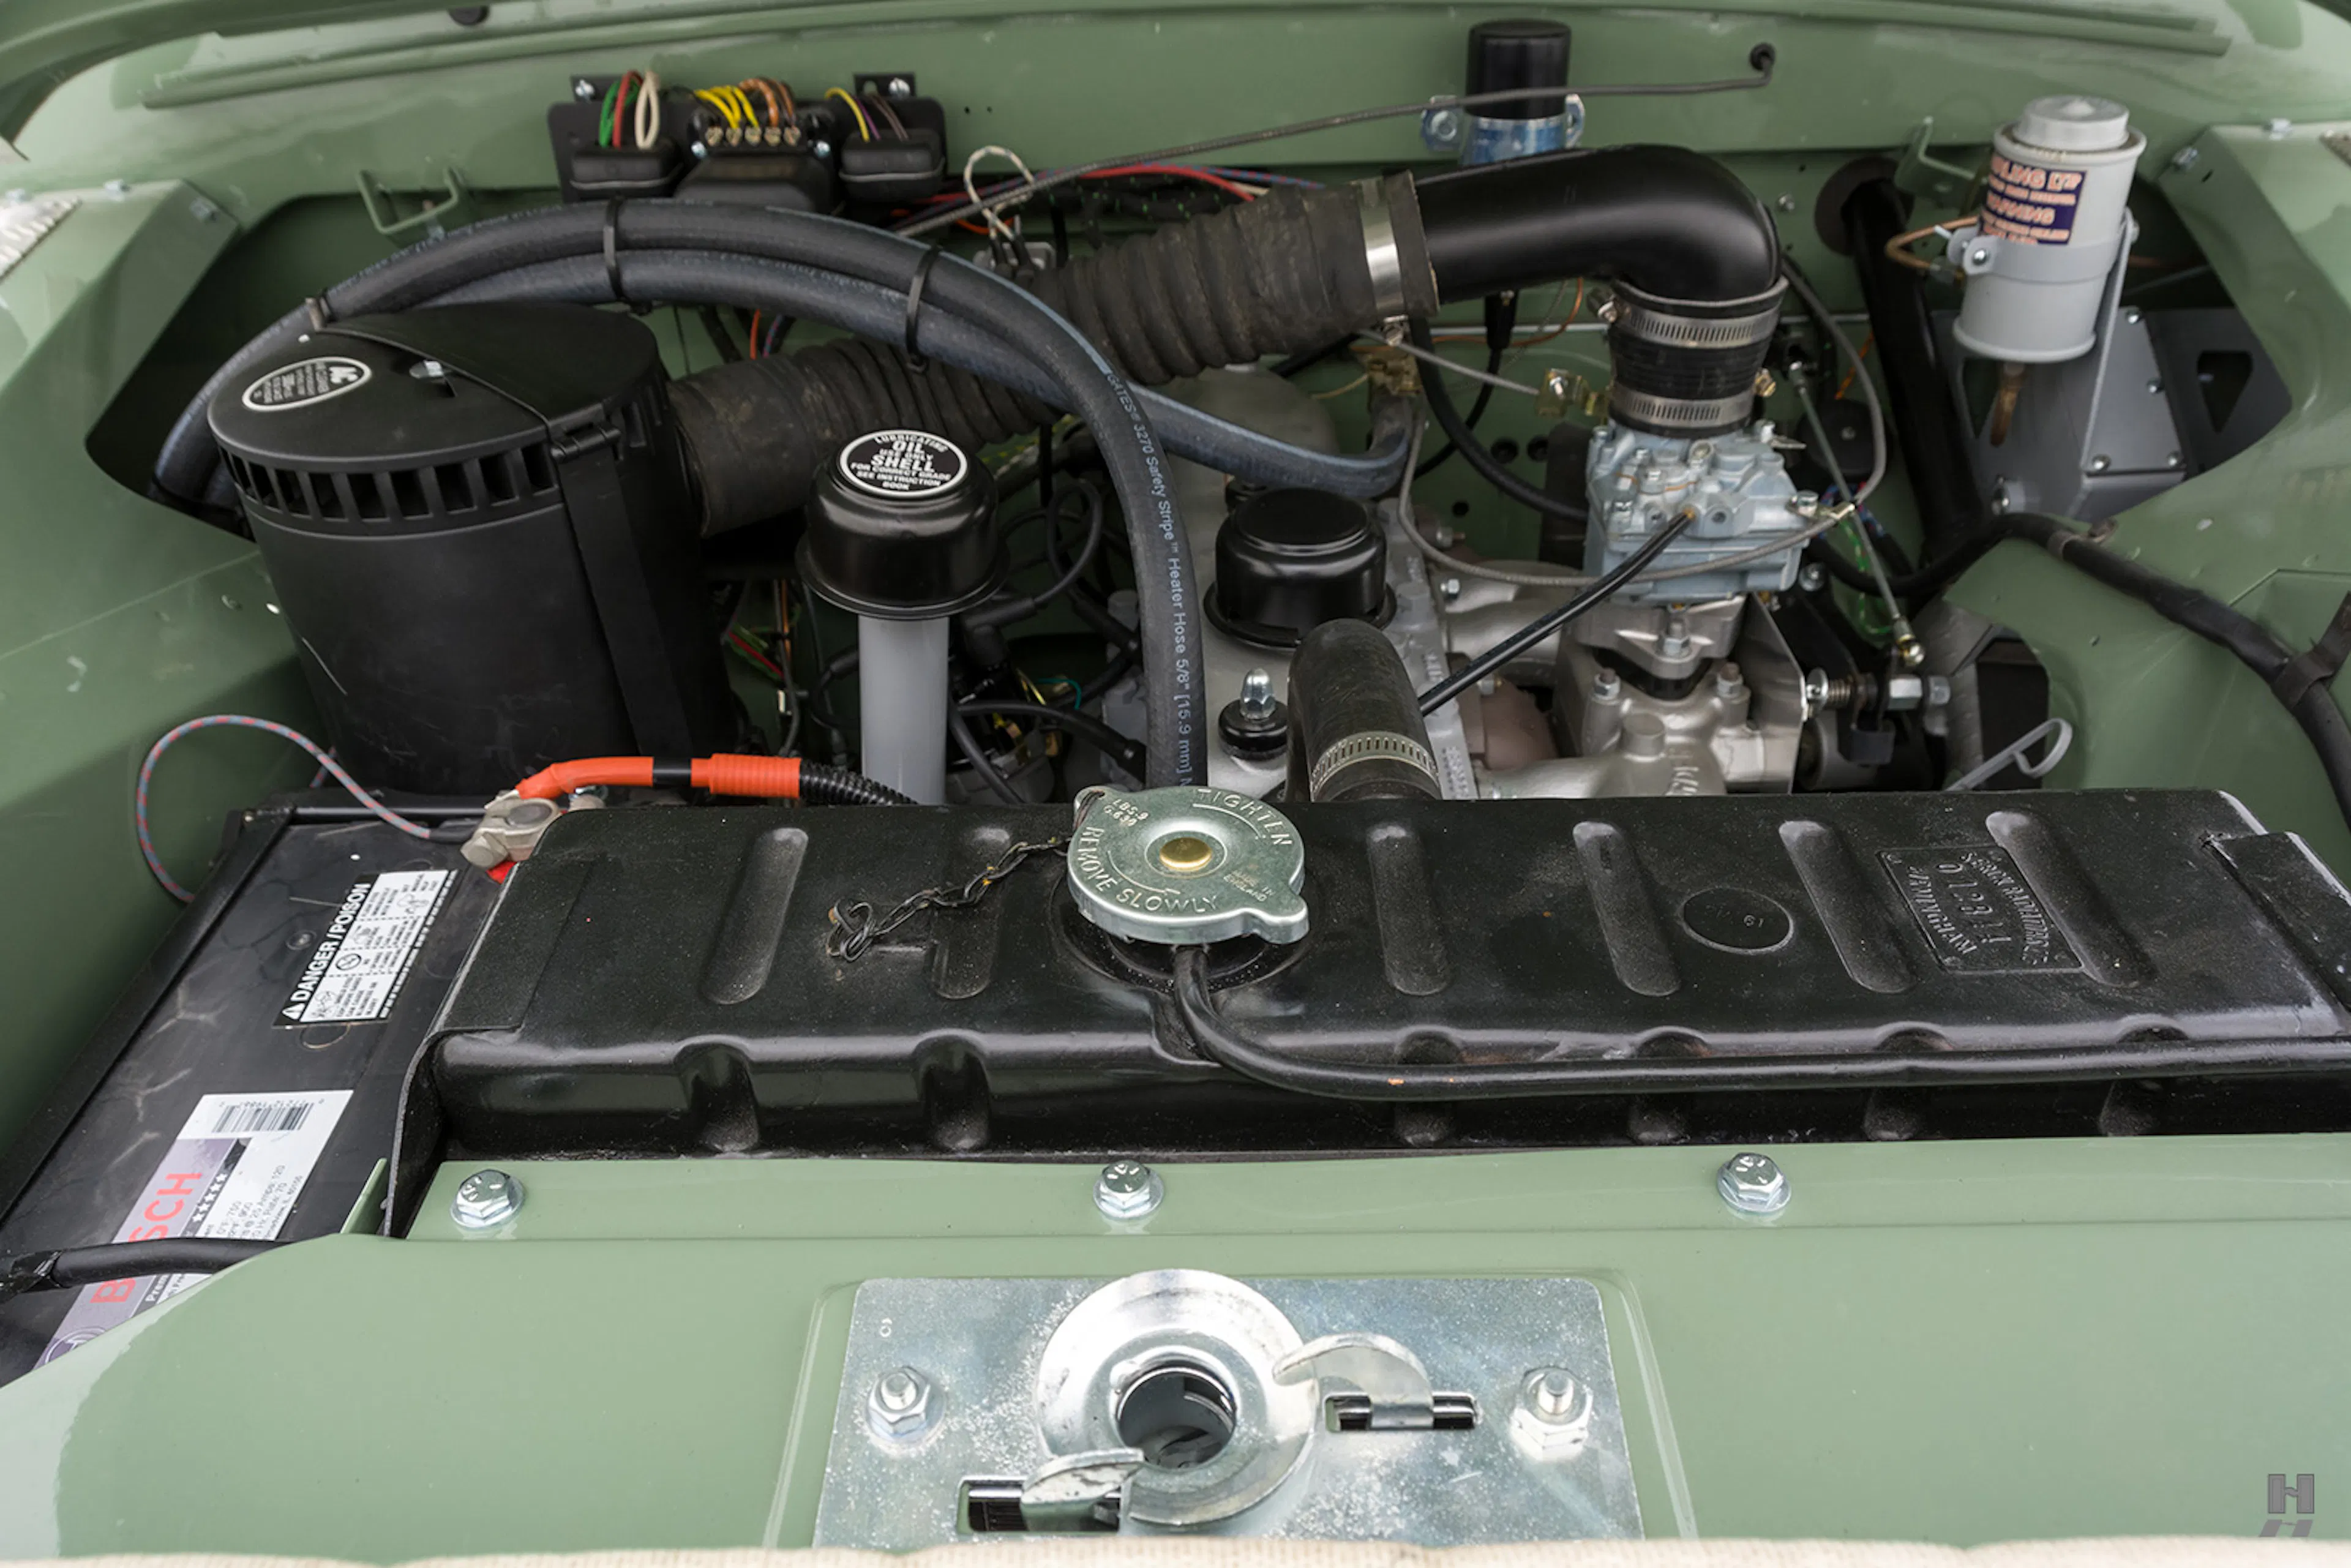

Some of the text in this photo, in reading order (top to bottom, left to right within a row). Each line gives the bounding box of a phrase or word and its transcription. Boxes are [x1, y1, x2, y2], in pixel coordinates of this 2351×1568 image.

[850, 462, 871, 471] FOR
[871, 454, 935, 473] SHELL
[879, 448, 934, 462] USE ONLY
[892, 440, 925, 454] OIL
[857, 471, 876, 479] SEE
[1146, 456, 1166, 498] Safety
[1168, 557, 1183, 609] Heater
[1173, 612, 1187, 653] Hose
[1198, 788, 1292, 846] TIGHTEN
[1077, 827, 1217, 913] REMOVE SLOWLY
[89, 1172, 203, 1304] BSCH
